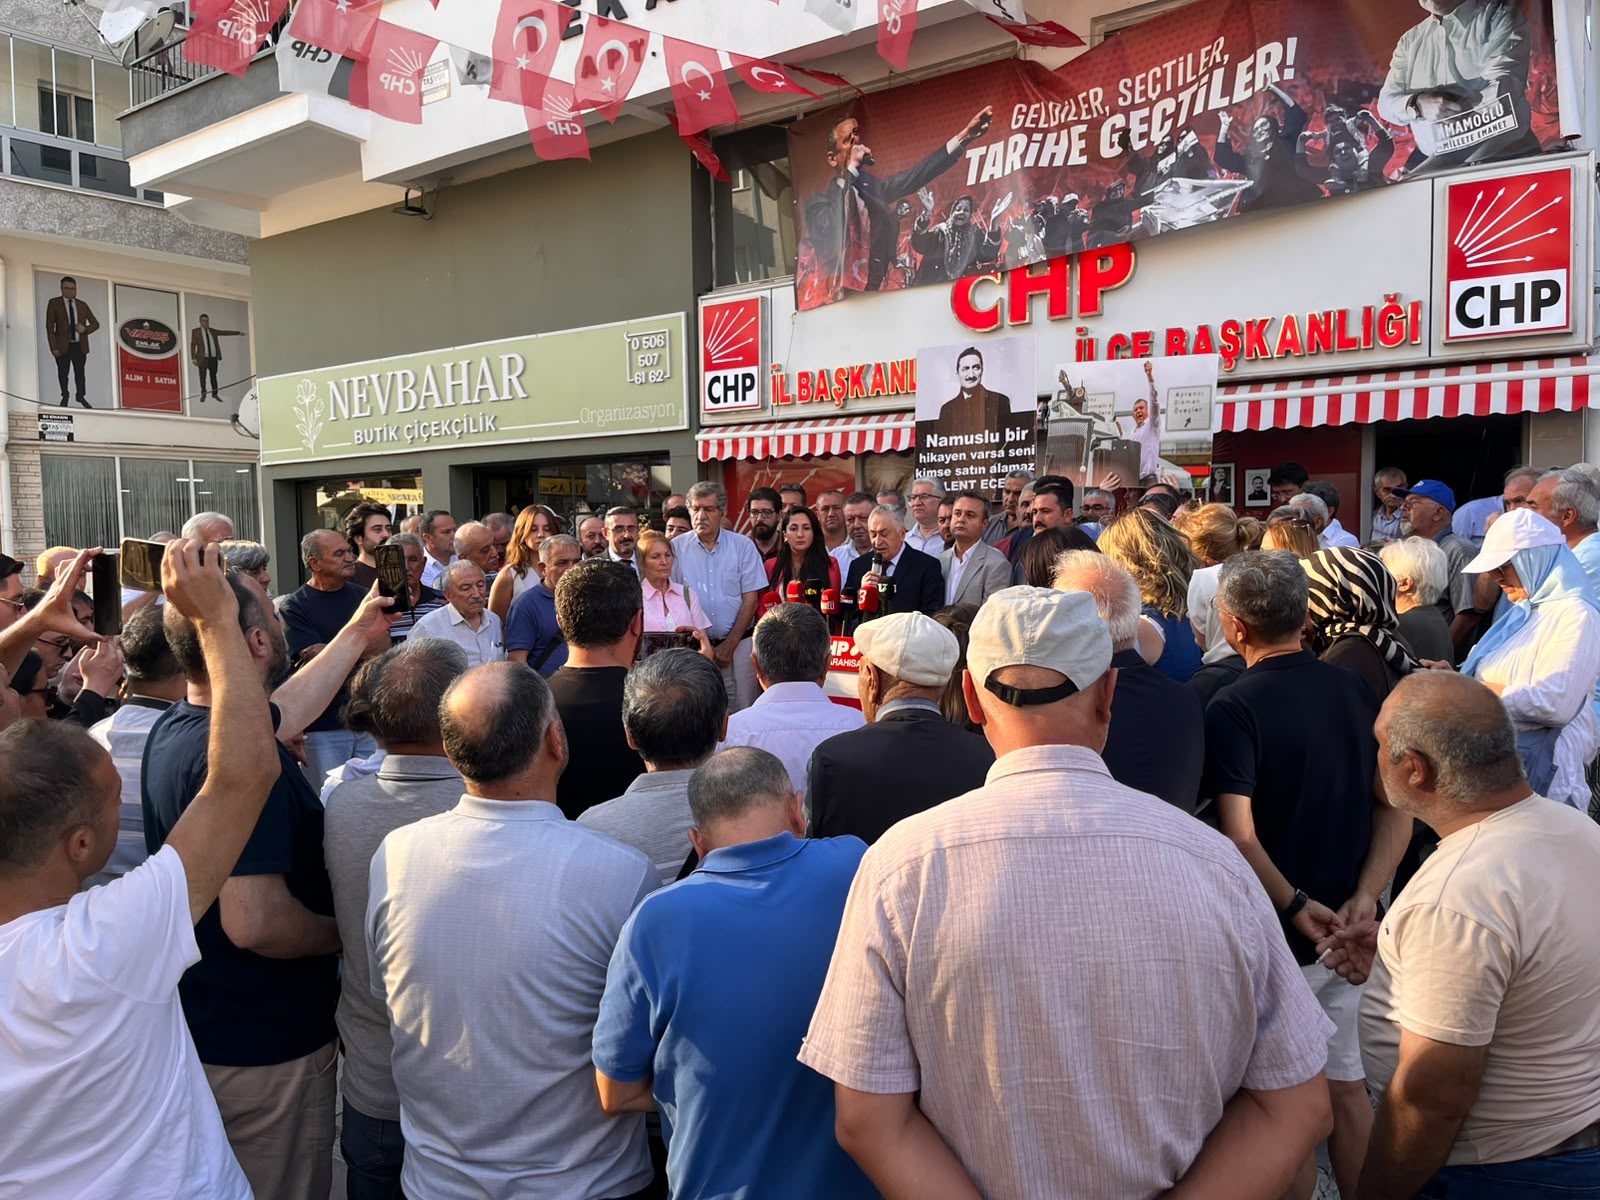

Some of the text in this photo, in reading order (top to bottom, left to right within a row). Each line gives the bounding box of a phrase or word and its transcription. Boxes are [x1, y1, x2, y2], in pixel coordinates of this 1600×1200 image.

[1010, 35, 1230, 130] GELDİLER, SEÇTİLER,
[965, 36, 1299, 186] TARİHE GEÇTİLER!
[1442, 120, 1508, 150] MİLLETE EMANET
[950, 242, 1138, 333] CHP
[1455, 277, 1562, 329] CHP
[631, 334, 665, 350] 0 506
[1165, 293, 1423, 372] BAŞKANLIĞI
[638, 353, 659, 367] 507
[154, 376, 177, 385] SATIM
[327, 352, 529, 421] NEVBAHAR
[648, 369, 665, 383] 62
[706, 369, 756, 405] CHP
[771, 358, 918, 409] İL BAŞKANL
[354, 410, 498, 445] BUTİK ÇİÇEKÇİLİK
[579, 402, 676, 428] Organizasyon
[926, 427, 1029, 448] Namuslu bir
[919, 444, 1035, 465] hikayen varsa seni
[915, 462, 1036, 479] kimse satın alamaz
[944, 477, 1006, 492] LENT ECE
[829, 640, 850, 657] HP
